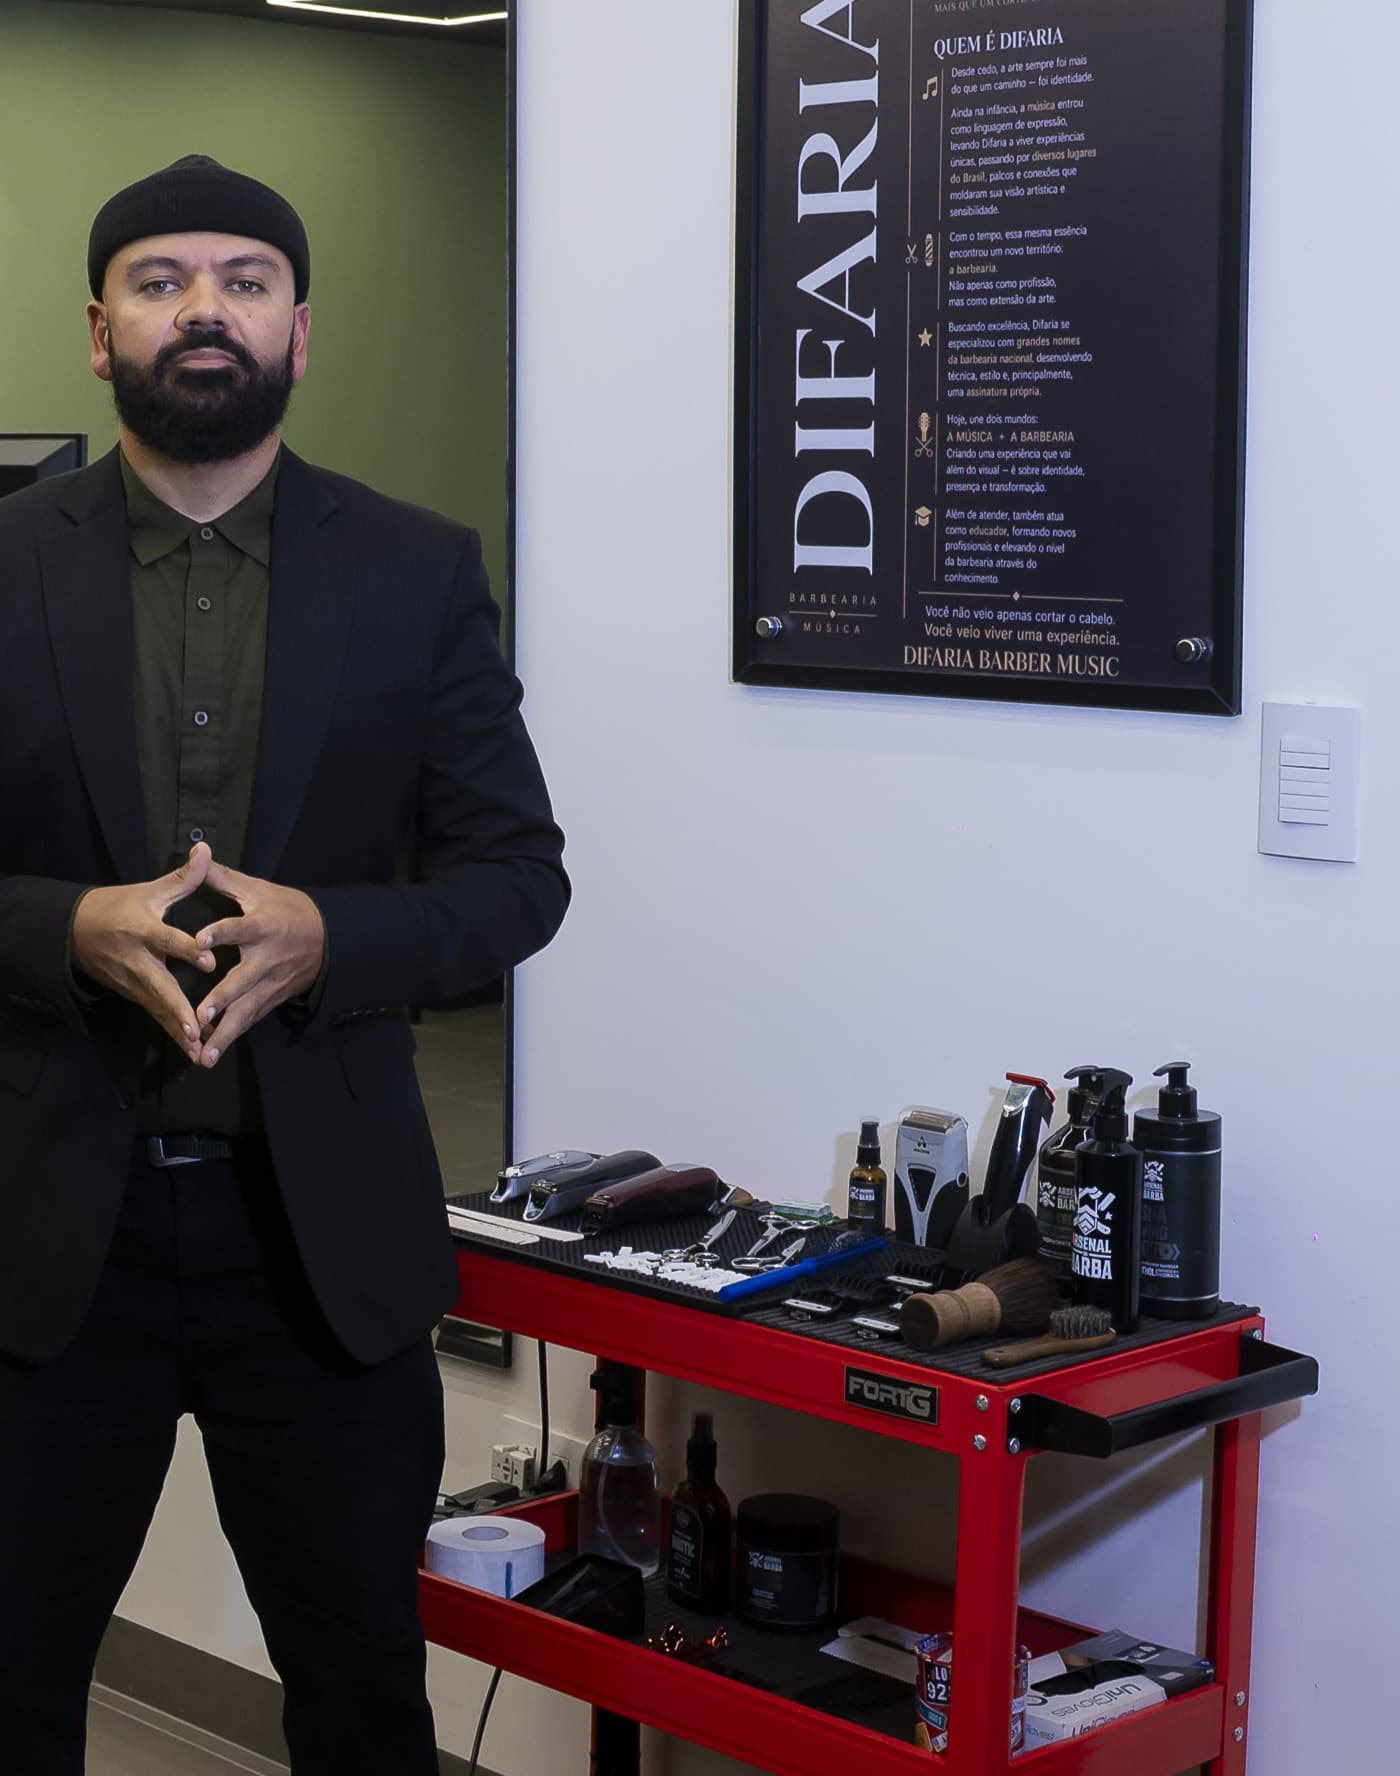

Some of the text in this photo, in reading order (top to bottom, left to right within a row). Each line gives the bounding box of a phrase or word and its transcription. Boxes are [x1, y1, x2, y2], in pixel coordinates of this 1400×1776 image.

[934, 27, 1063, 59] QUEM É DIFARIA
[951, 55, 1087, 77] Desde cedo, arte sempre foi mais
[951, 72, 1093, 94] do que um caminho foi identidade.
[951, 107, 972, 118] Ainda
[986, 104, 1017, 115] infância,
[1027, 100, 1055, 111] música
[1057, 99, 1083, 109] entrou
[950, 116, 1067, 134] como linguagem de expressão,
[950, 131, 1084, 150] levando Difaria viver experiências
[950, 148, 1096, 167] únicas, passando por diversos lugares
[950, 166, 1077, 183] do Brasil, palcos conexões que
[950, 184, 1057, 199] moldaram sua visão artística
[950, 204, 999, 216] sensibilidade.
[949, 225, 1087, 242] Com tempo, essa mesma essência
[949, 243, 1063, 258] encontrou um novo território:
[956, 263, 998, 274] barbearia.
[794, 0, 878, 576] DIFARIA
[949, 276, 1056, 291] Não apenas como profissão,
[948, 293, 1056, 306] mas como extensão da arte.
[948, 319, 1069, 332] Buscando excelência, Difaria se
[948, 336, 1079, 350] especializou com grandes nomes
[948, 351, 1092, 364] da barbearia nacional, desenvolvendo
[948, 369, 1072, 381] técnica, estilo e, principalmente,
[947, 385, 1041, 398] uma assinatura própria.
[947, 413, 1038, 426] Hoje, une dois mundos:
[946, 429, 1074, 442] A MÚSICA A BARBEARIA
[946, 447, 1071, 460] Criando uma experiência que vai
[946, 464, 1084, 476] além do visual sobre identidade,
[946, 481, 1046, 493] presença transformação.
[945, 509, 1063, 521] Além de atender, também atua
[945, 525, 1076, 537] como educador, formando novos
[945, 540, 1064, 553] profissionais elevando nível
[944, 556, 1037, 568] da barbearia através do
[944, 572, 999, 583] conhecimento.
[789, 592, 875, 605] BARBEARIA
[925, 605, 1115, 624] Você não veio apenas cortar cabelo.
[924, 623, 1119, 646] Você veio viver uma experiência.
[904, 646, 1118, 676] DIFARIA BARBER MUSIC
[848, 1375, 932, 1417] FORTG
